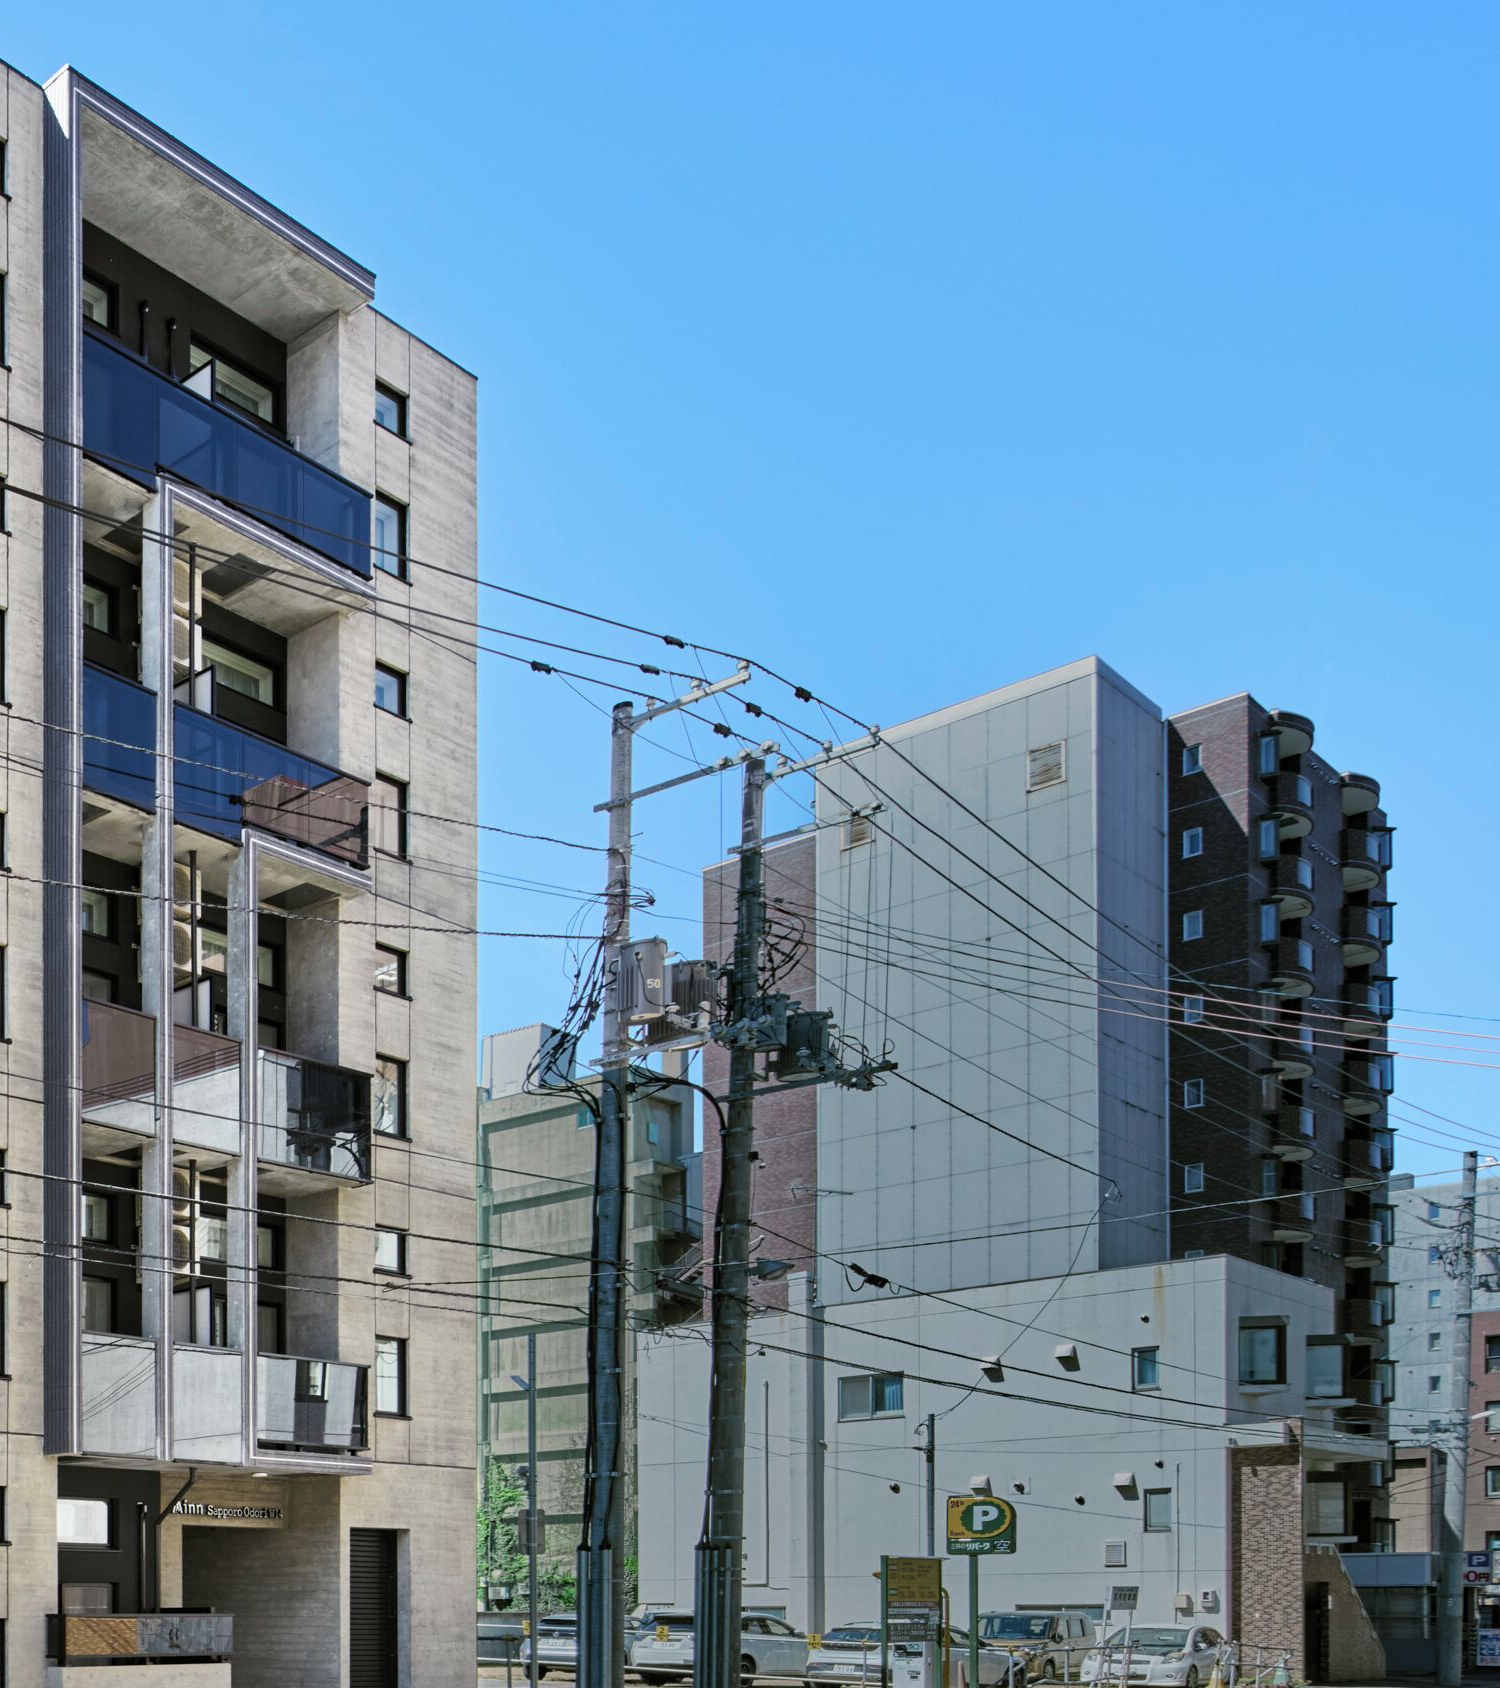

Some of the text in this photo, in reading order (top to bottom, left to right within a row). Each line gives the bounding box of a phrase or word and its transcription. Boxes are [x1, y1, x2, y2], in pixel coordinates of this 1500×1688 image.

[647, 979, 660, 988] 50
[172, 1499, 204, 1515] Ainn
[207, 1504, 243, 1519] Sapporo
[243, 1506, 268, 1518] Odori
[972, 1505, 999, 1531] P
[994, 1540, 1011, 1552] 空
[1472, 1555, 1486, 1565] P
